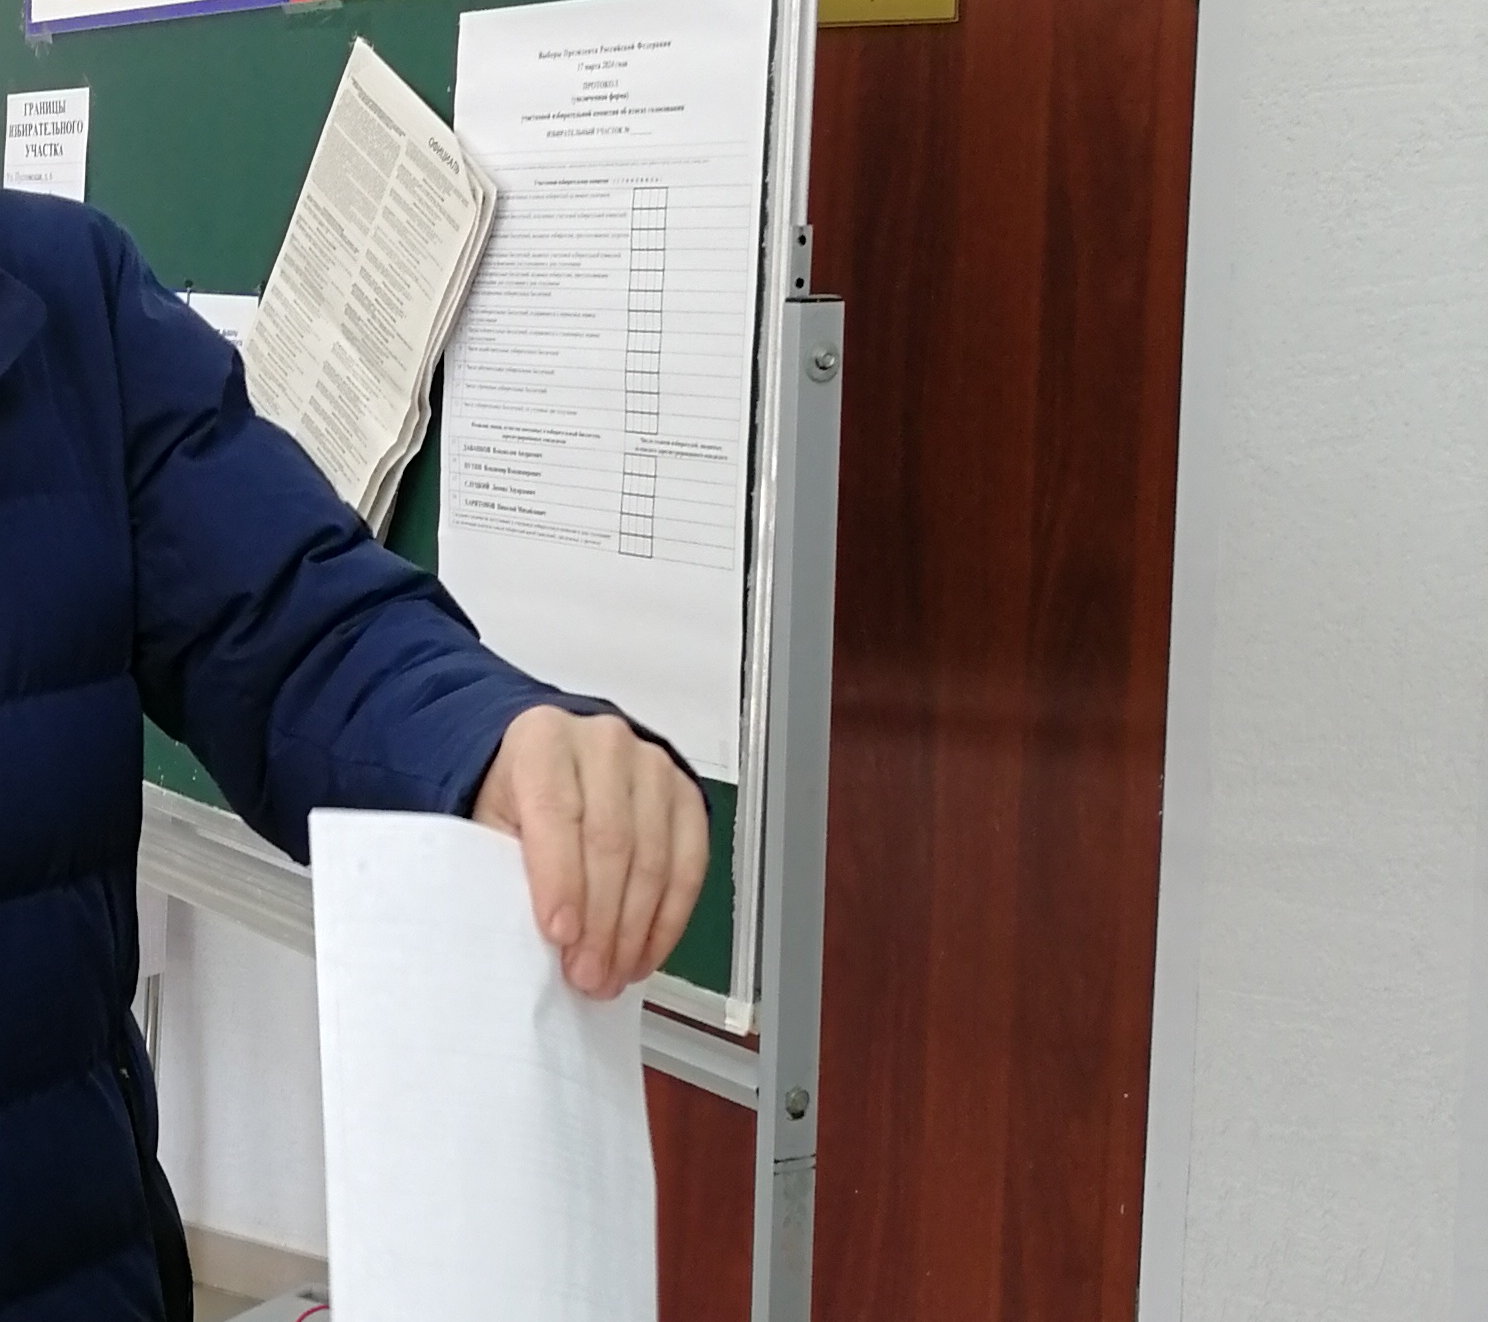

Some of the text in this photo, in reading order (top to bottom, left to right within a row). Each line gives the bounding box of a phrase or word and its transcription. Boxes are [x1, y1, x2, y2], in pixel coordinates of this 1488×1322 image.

[23, 99, 67, 117] ГРАНИЦЫ
[8, 119, 84, 139] ИЗБИРАТЕЛЬНОГО
[25, 142, 64, 158] УЧАСТКА
